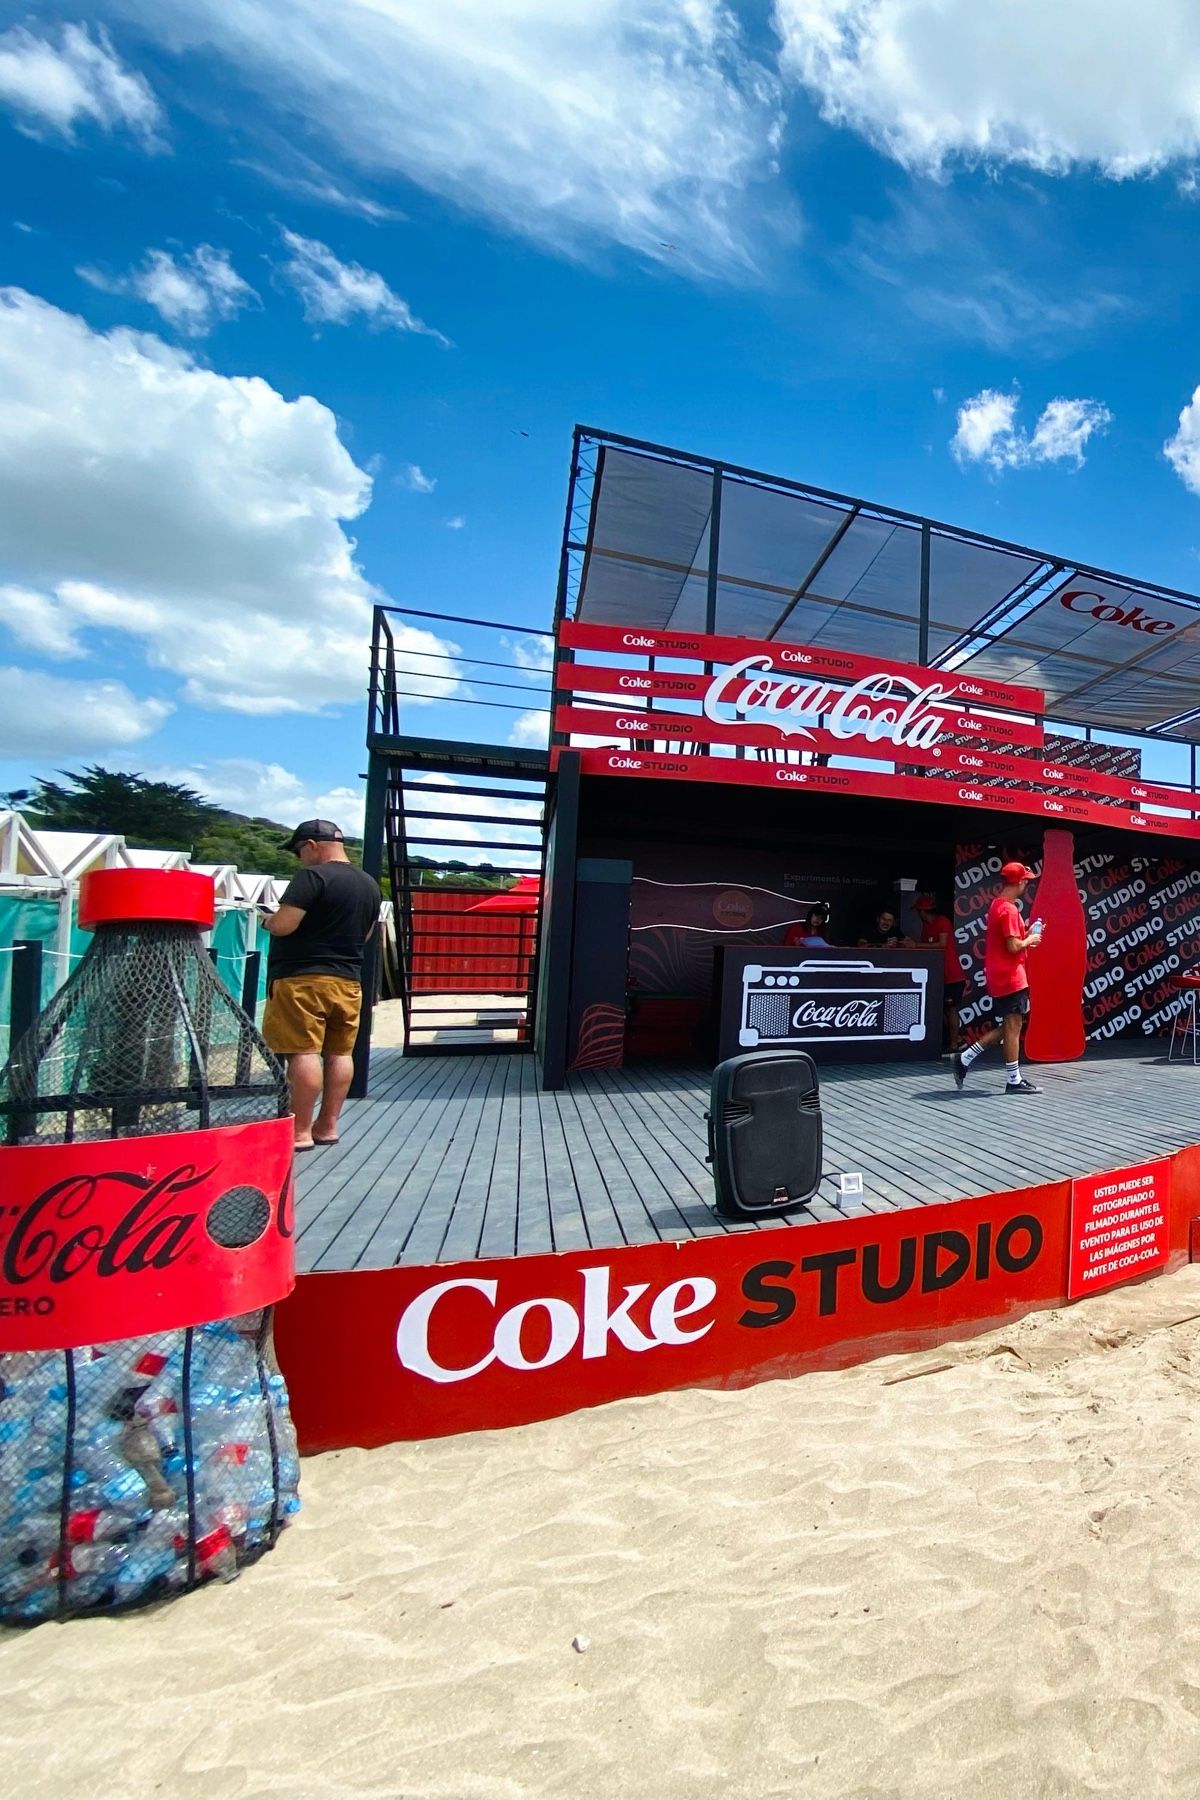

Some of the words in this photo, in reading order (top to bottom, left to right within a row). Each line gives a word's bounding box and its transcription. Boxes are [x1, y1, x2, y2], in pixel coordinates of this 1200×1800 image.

[1059, 590, 1175, 635] Coke
[622, 634, 655, 647] Coke
[656, 639, 700, 650] STUDIO
[780, 650, 812, 664] Coke
[813, 656, 854, 669] STUDIO
[619, 675, 652, 689] Coke
[653, 679, 697, 691] STUDIO
[959, 682, 983, 696] Coke
[984, 688, 1015, 701] STUDIO
[703, 654, 957, 750] Coca-Cola
[615, 718, 648, 731] Coke
[650, 723, 693, 734] STUDIO
[957, 717, 982, 731] Coke
[983, 724, 1014, 736] STUDIO
[608, 756, 641, 770] Coke
[643, 761, 688, 773] STUDIO
[959, 754, 983, 767] Coke
[984, 760, 1015, 772] STUDIO
[1090, 752, 1111, 766] STUDIO
[1112, 750, 1132, 764] STUDIO
[775, 769, 807, 782] Coke
[809, 775, 850, 786] STUDIO
[1043, 767, 1064, 779] Coke
[1064, 773, 1089, 783] STUDIO
[958, 788, 983, 801] Coke
[984, 794, 1015, 804] STUDIO
[1131, 787, 1147, 797] Coke
[1043, 800, 1063, 812] Coke
[1064, 806, 1089, 815] STUDIO
[1130, 815, 1146, 826] Coke
[954, 856, 1003, 889] UDIO
[1073, 854, 1115, 879] STUD
[1087, 864, 1129, 895] Coke
[1088, 879, 1146, 921] STUDIO
[1106, 902, 1149, 934] Coke
[1107, 917, 1164, 959] STUDIO
[1163, 892, 1200, 922] Coke
[1083, 966, 1125, 999] UDIO
[1123, 939, 1166, 972] Coke
[1082, 990, 1125, 1025] Coke
[1124, 954, 1180, 998] STUDIO
[792, 1000, 883, 1028] Coca-Cola
[1086, 1005, 1142, 1041] TUDIO
[1142, 990, 1196, 1035] STUDIO
[1094, 1185, 1117, 1199] USTED
[1118, 1178, 1141, 1192] PUEDE
[1141, 1175, 1154, 1187] SER
[1092, 1192, 1147, 1215] FOTOGRAFIADO
[1147, 1190, 1155, 1199] O
[1085, 1214, 1119, 1233] FILMADO
[1119, 1205, 1152, 1220] DURANTE
[1152, 1202, 1160, 1213] EL
[1080, 1233, 1110, 1250] EVENTO
[1111, 1227, 1131, 1242] PARA
[1131, 1224, 1139, 1234] EL
[1140, 1219, 1154, 1231] USO
[1154, 1216, 1164, 1227] DE
[1089, 1249, 1103, 1263] LAS
[1104, 1237, 1140, 1258] IMÁGENES
[1140, 1233, 1155, 1245] POR
[1083, 1264, 1107, 1280] PARTE
[1108, 1259, 1119, 1271] DE
[1118, 1246, 1160, 1268] COCA-COLA.
[0, 1296, 55, 1317] ERO
[396, 1265, 717, 1383] Coke
[737, 1214, 1043, 1329] STUDIO
